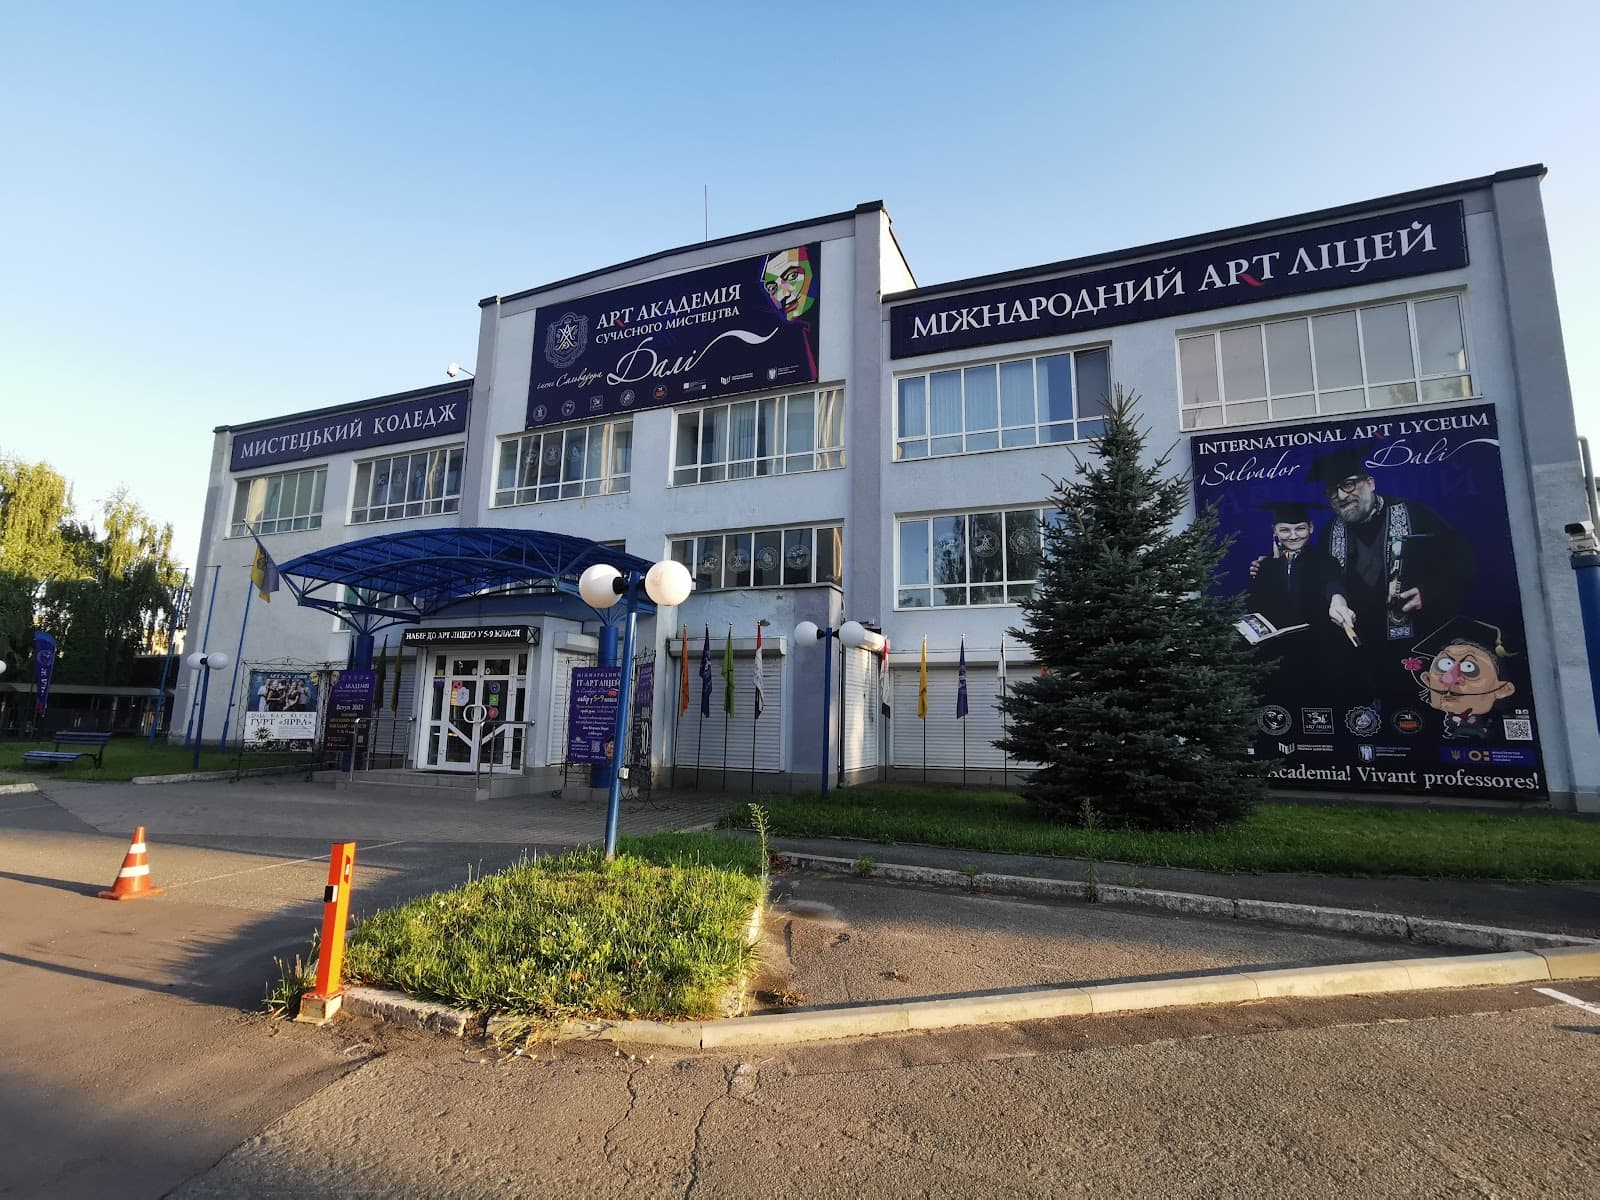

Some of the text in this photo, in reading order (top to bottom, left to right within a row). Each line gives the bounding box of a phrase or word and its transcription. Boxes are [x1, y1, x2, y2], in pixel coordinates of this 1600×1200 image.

[636, 283, 741, 317] АКАДЕМІЯ
[911, 266, 1185, 339] МІЖНАРОДНИЙ
[1287, 220, 1437, 273] ЛІЦЕЙ
[595, 305, 740, 344] СУЧАСНОГО МИСТЕЦТВА
[606, 331, 735, 386] Далі
[240, 403, 457, 459] МИСТЕЦЬКИЙ КОЛЕДЖ
[1198, 428, 1347, 455] INTERNATIONAL
[1400, 412, 1489, 435] LYCEUM
[1200, 437, 1473, 486] Salvador Dali
[1356, 766, 1417, 784] Vivant
[1424, 769, 1540, 790] professores!
